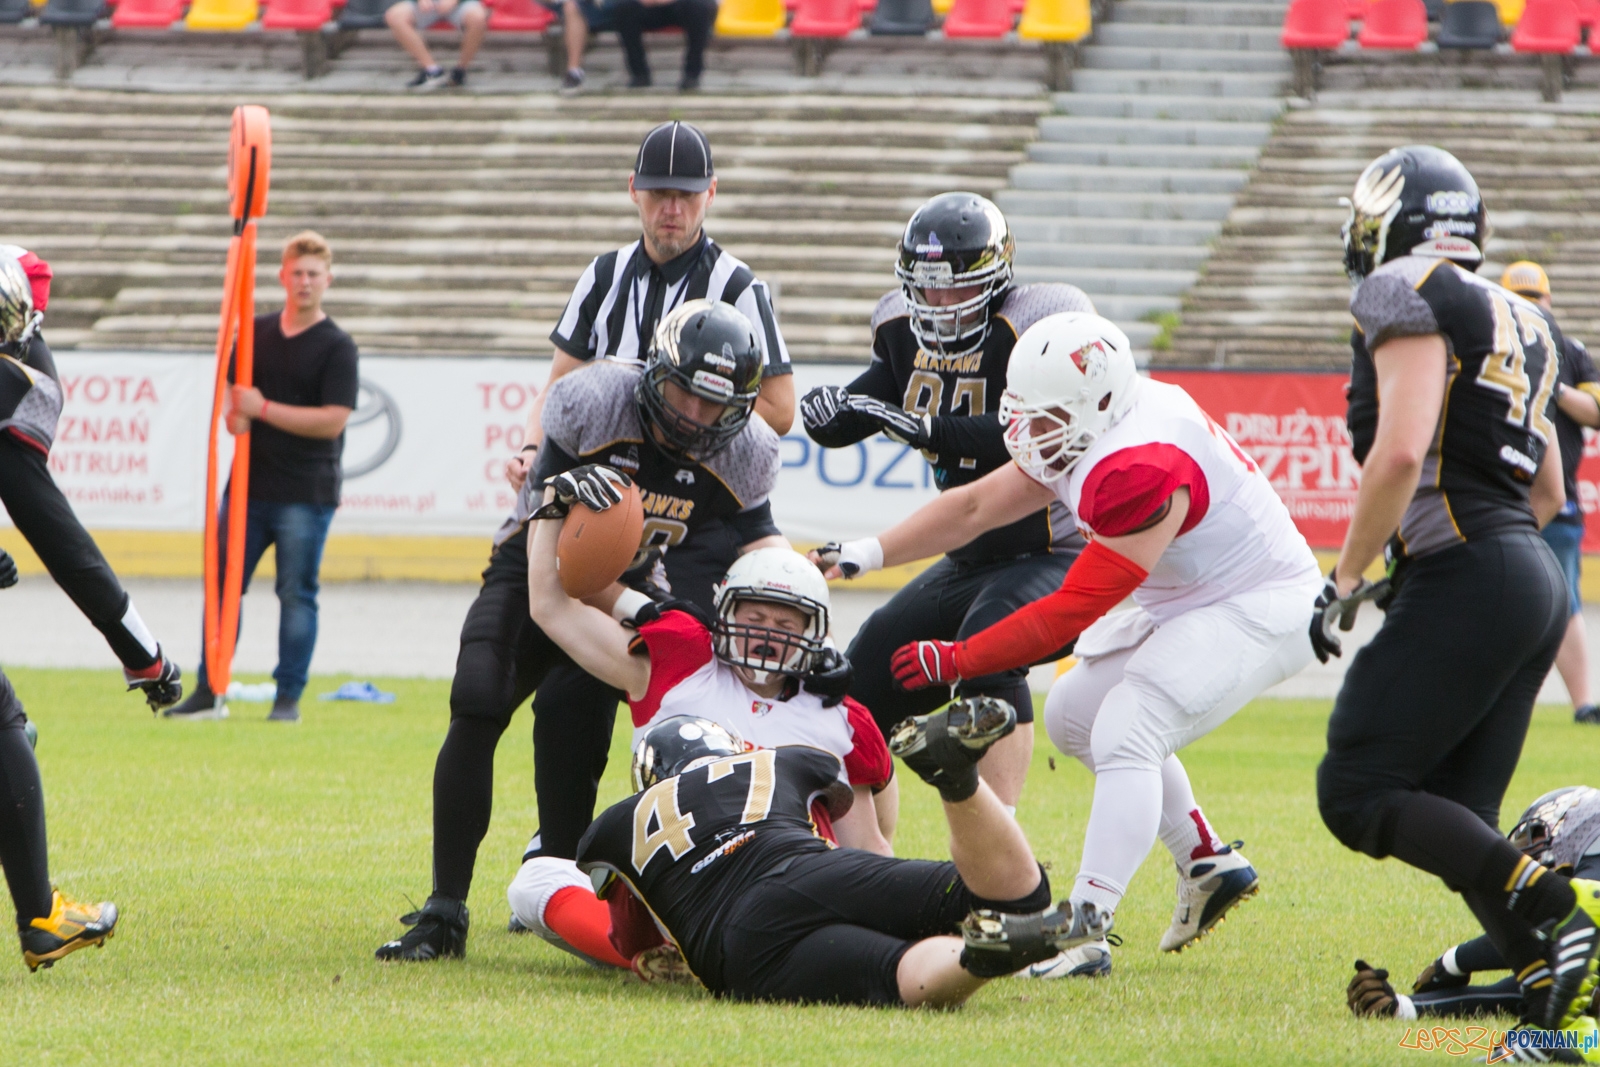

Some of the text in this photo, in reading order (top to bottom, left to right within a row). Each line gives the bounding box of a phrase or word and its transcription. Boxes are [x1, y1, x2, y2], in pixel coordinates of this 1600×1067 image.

[63, 375, 159, 404] YOTA
[60, 410, 150, 444] ZNAŃ
[1225, 408, 1351, 446] DRUŻYN
[51, 452, 148, 475] NTRUM
[631, 749, 777, 877] 47
